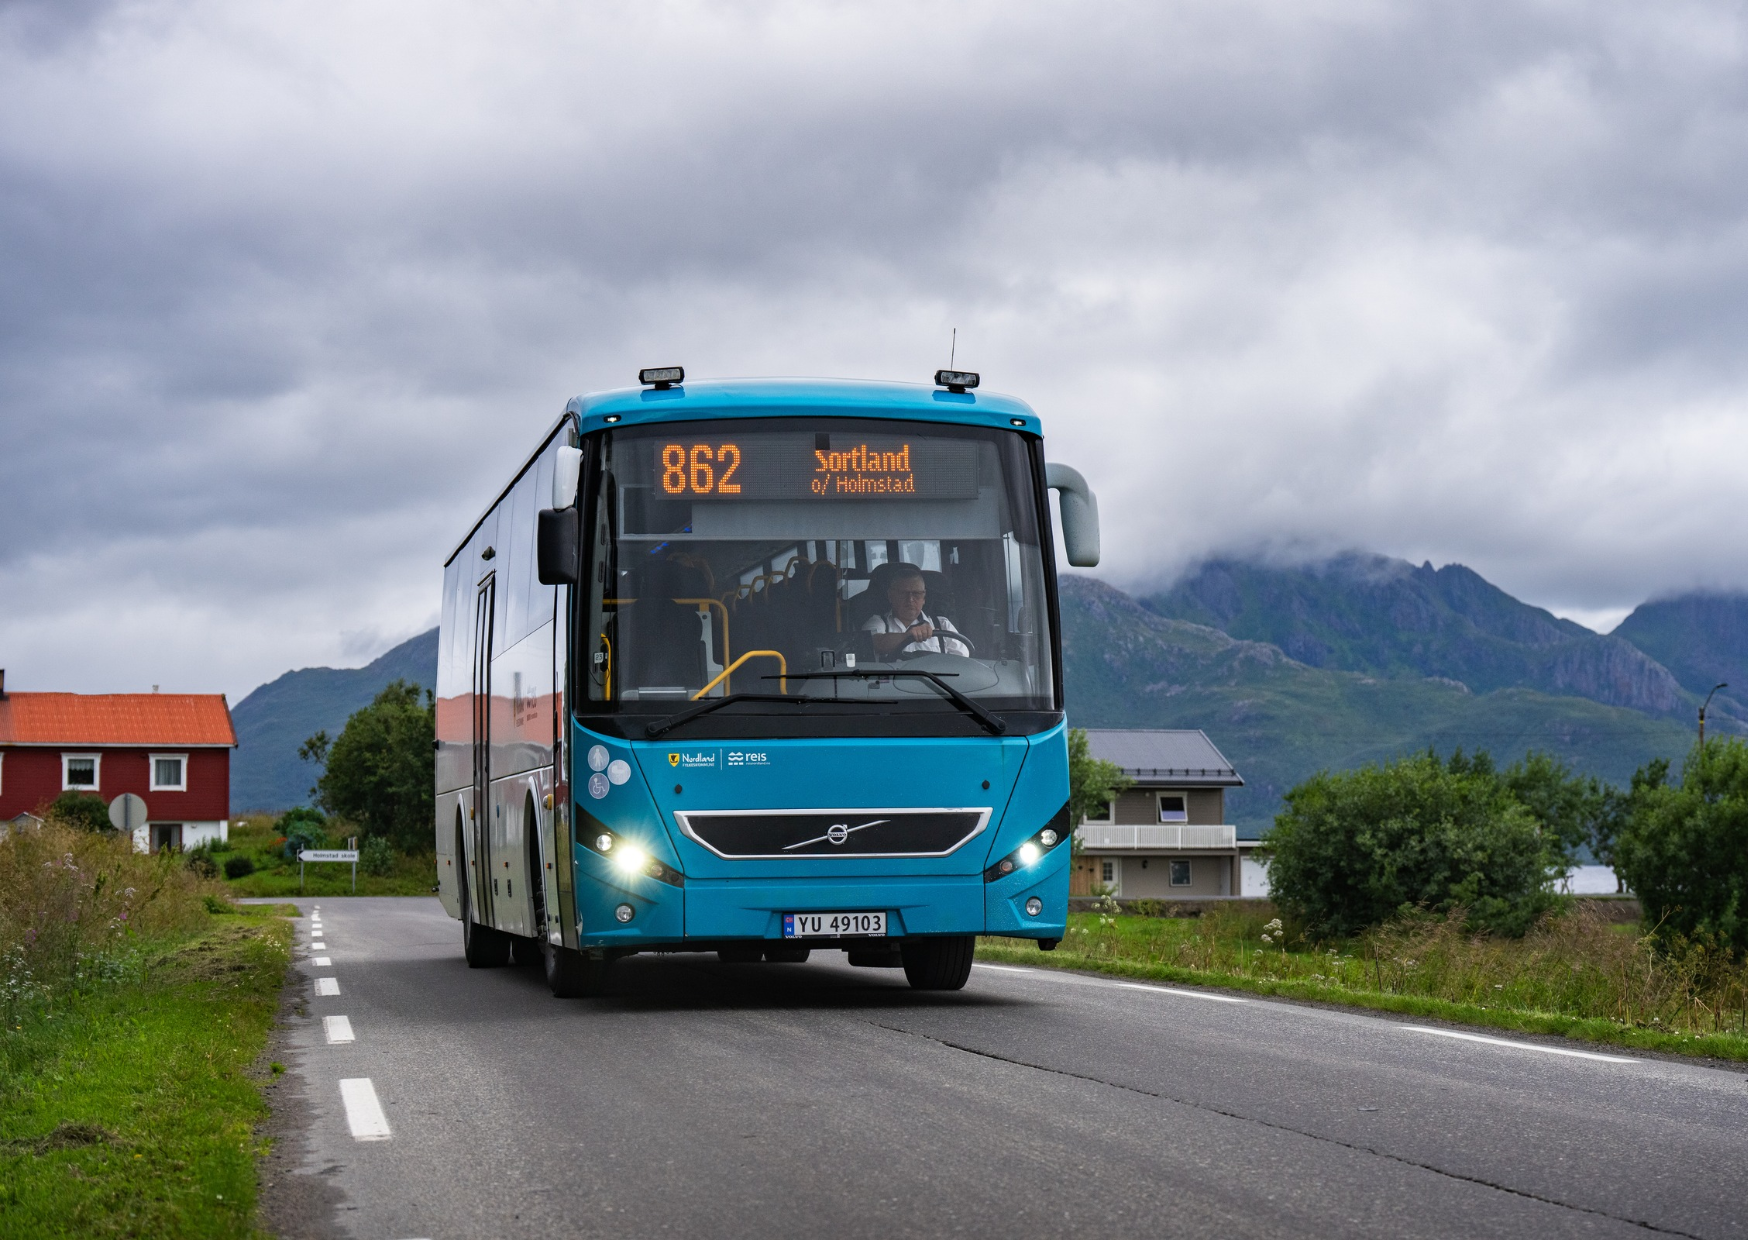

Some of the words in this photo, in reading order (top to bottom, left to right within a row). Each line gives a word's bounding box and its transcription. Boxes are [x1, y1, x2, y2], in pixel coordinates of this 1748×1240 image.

[815, 444, 911, 471] Sortland
[662, 444, 741, 493] 862
[811, 473, 830, 495] o/
[836, 473, 915, 493] Holmstad
[682, 752, 715, 762] Nordland
[745, 752, 767, 762] reis
[798, 916, 822, 933] YU
[830, 916, 882, 932] 49103
